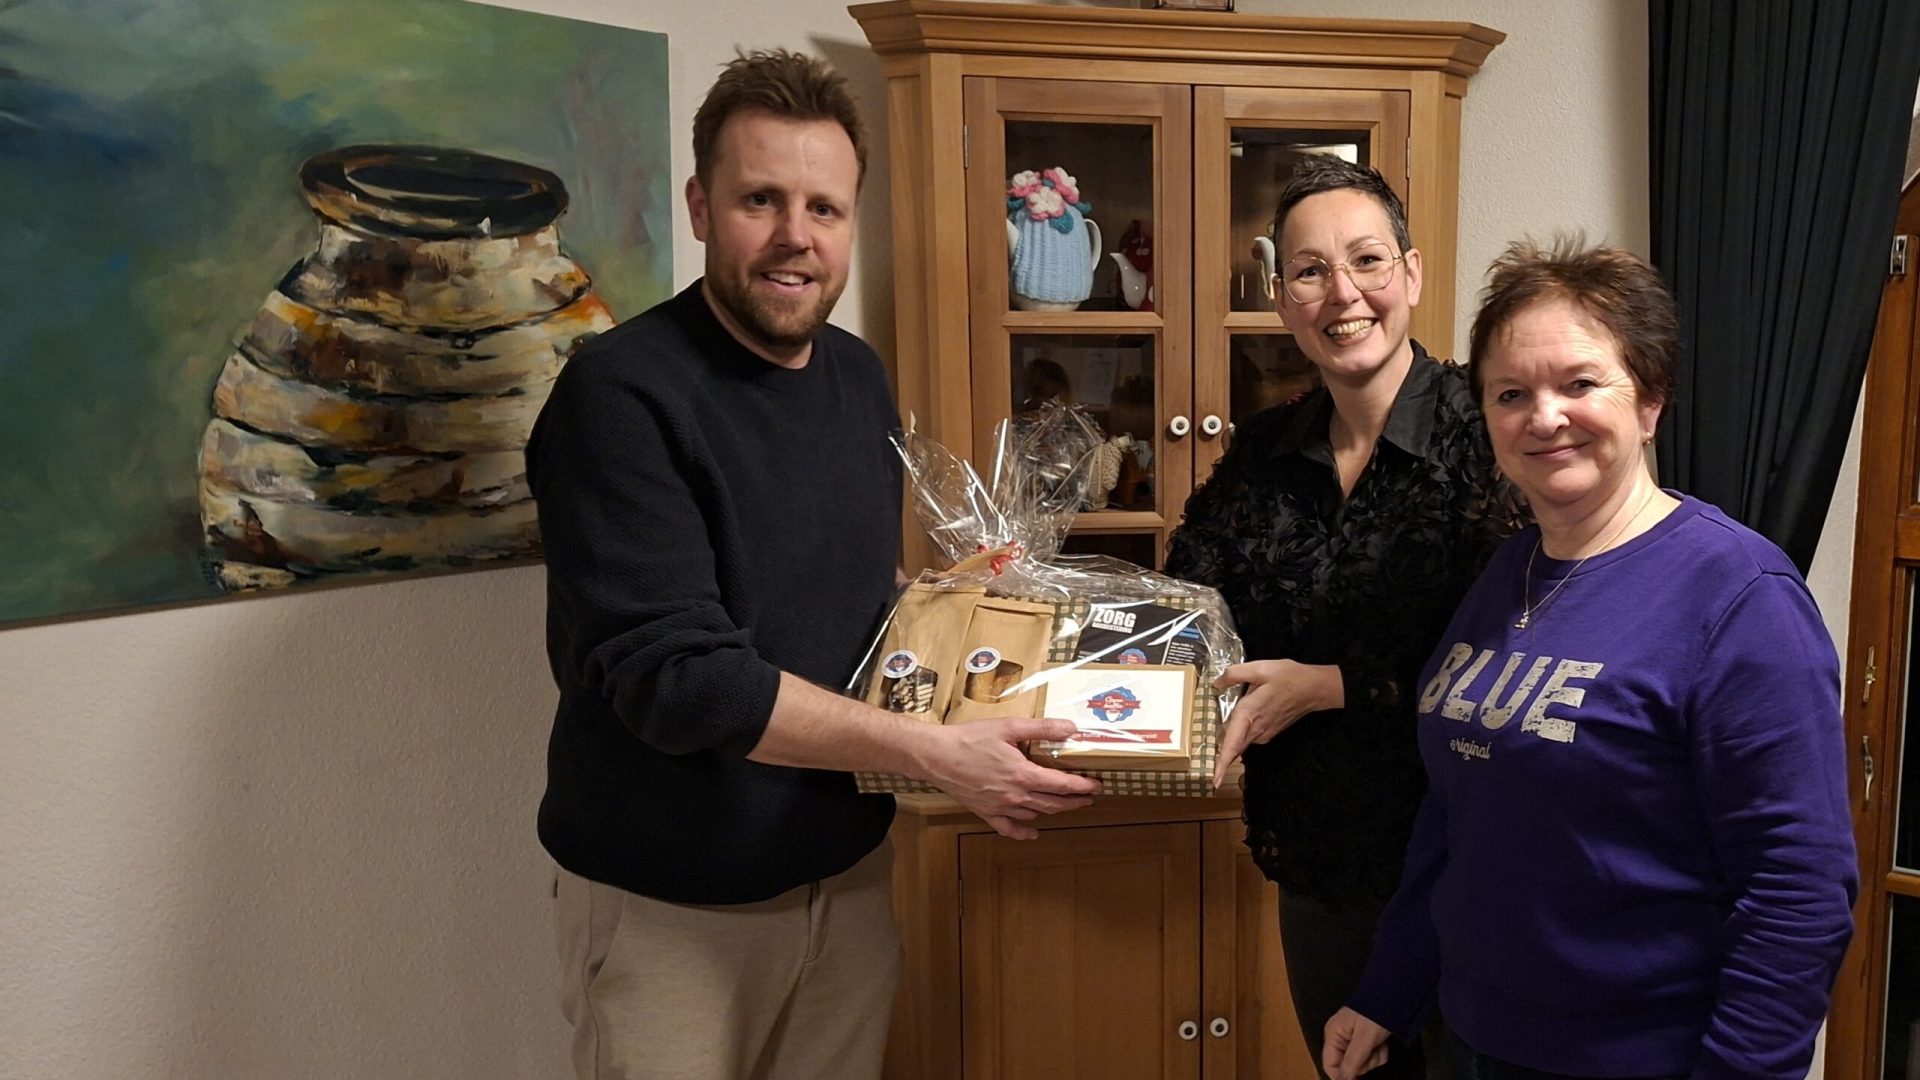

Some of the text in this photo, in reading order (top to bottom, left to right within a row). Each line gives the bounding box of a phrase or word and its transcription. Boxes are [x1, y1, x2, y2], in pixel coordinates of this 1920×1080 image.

[1093, 608, 1137, 628] ZORG
[1418, 642, 1604, 743] BLUE
[1450, 737, 1492, 761] original
